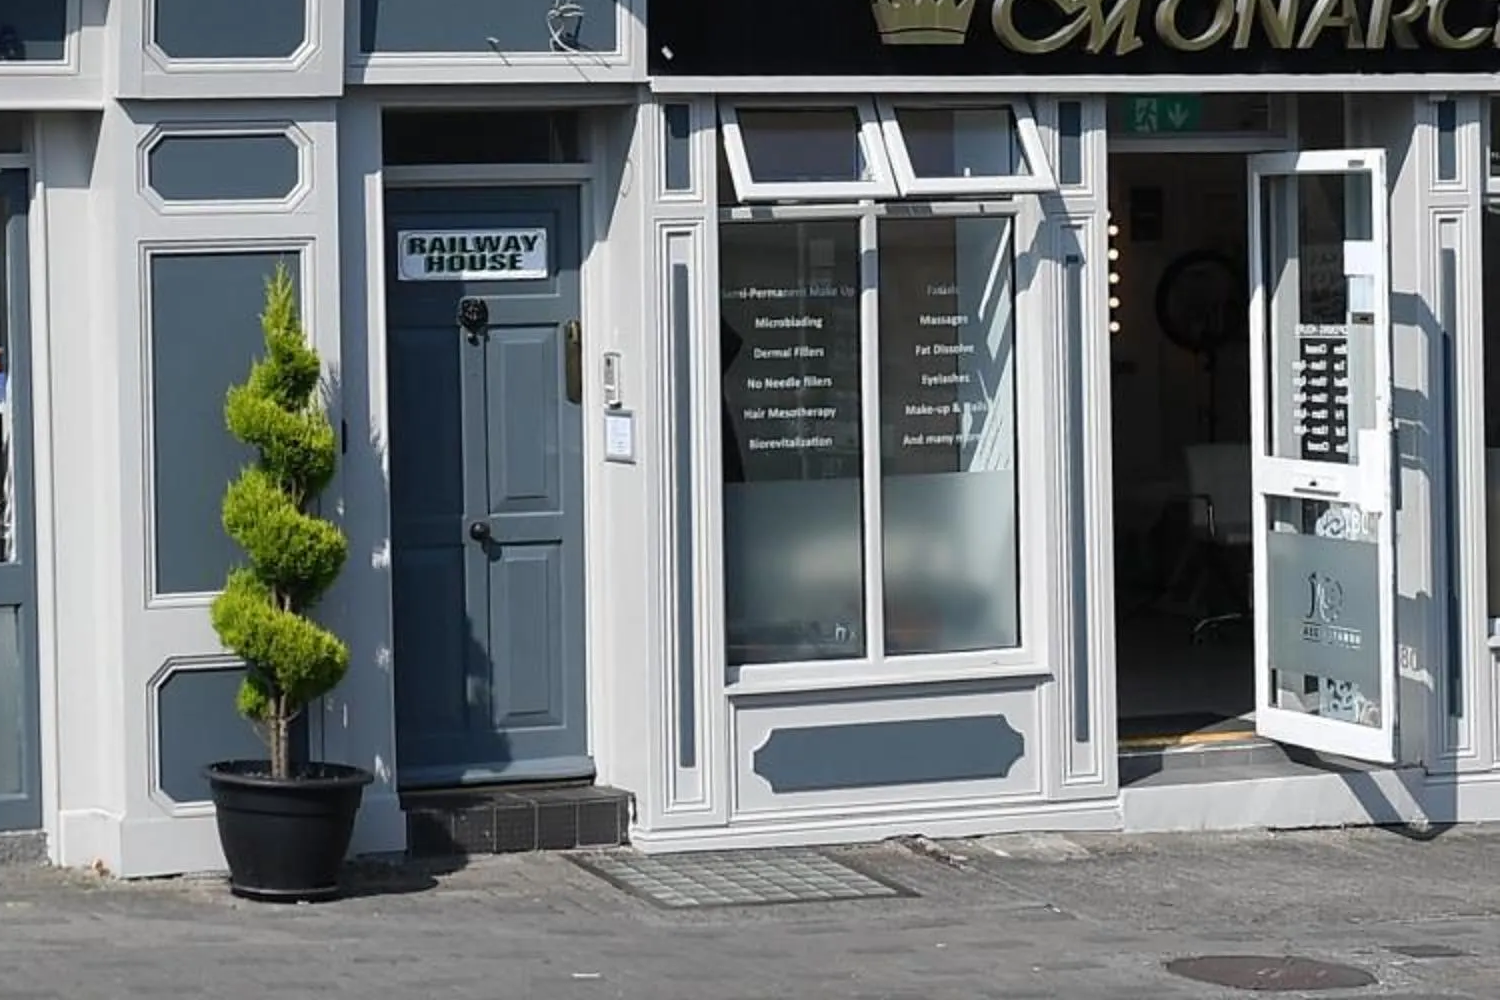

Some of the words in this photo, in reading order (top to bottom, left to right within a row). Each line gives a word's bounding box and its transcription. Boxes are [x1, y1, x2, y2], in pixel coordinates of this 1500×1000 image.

[407, 234, 540, 256] RAILWAY
[424, 252, 525, 274] HOUSE
[755, 315, 824, 330] Microblading
[747, 377, 763, 390] No
[765, 376, 801, 389] Needle
